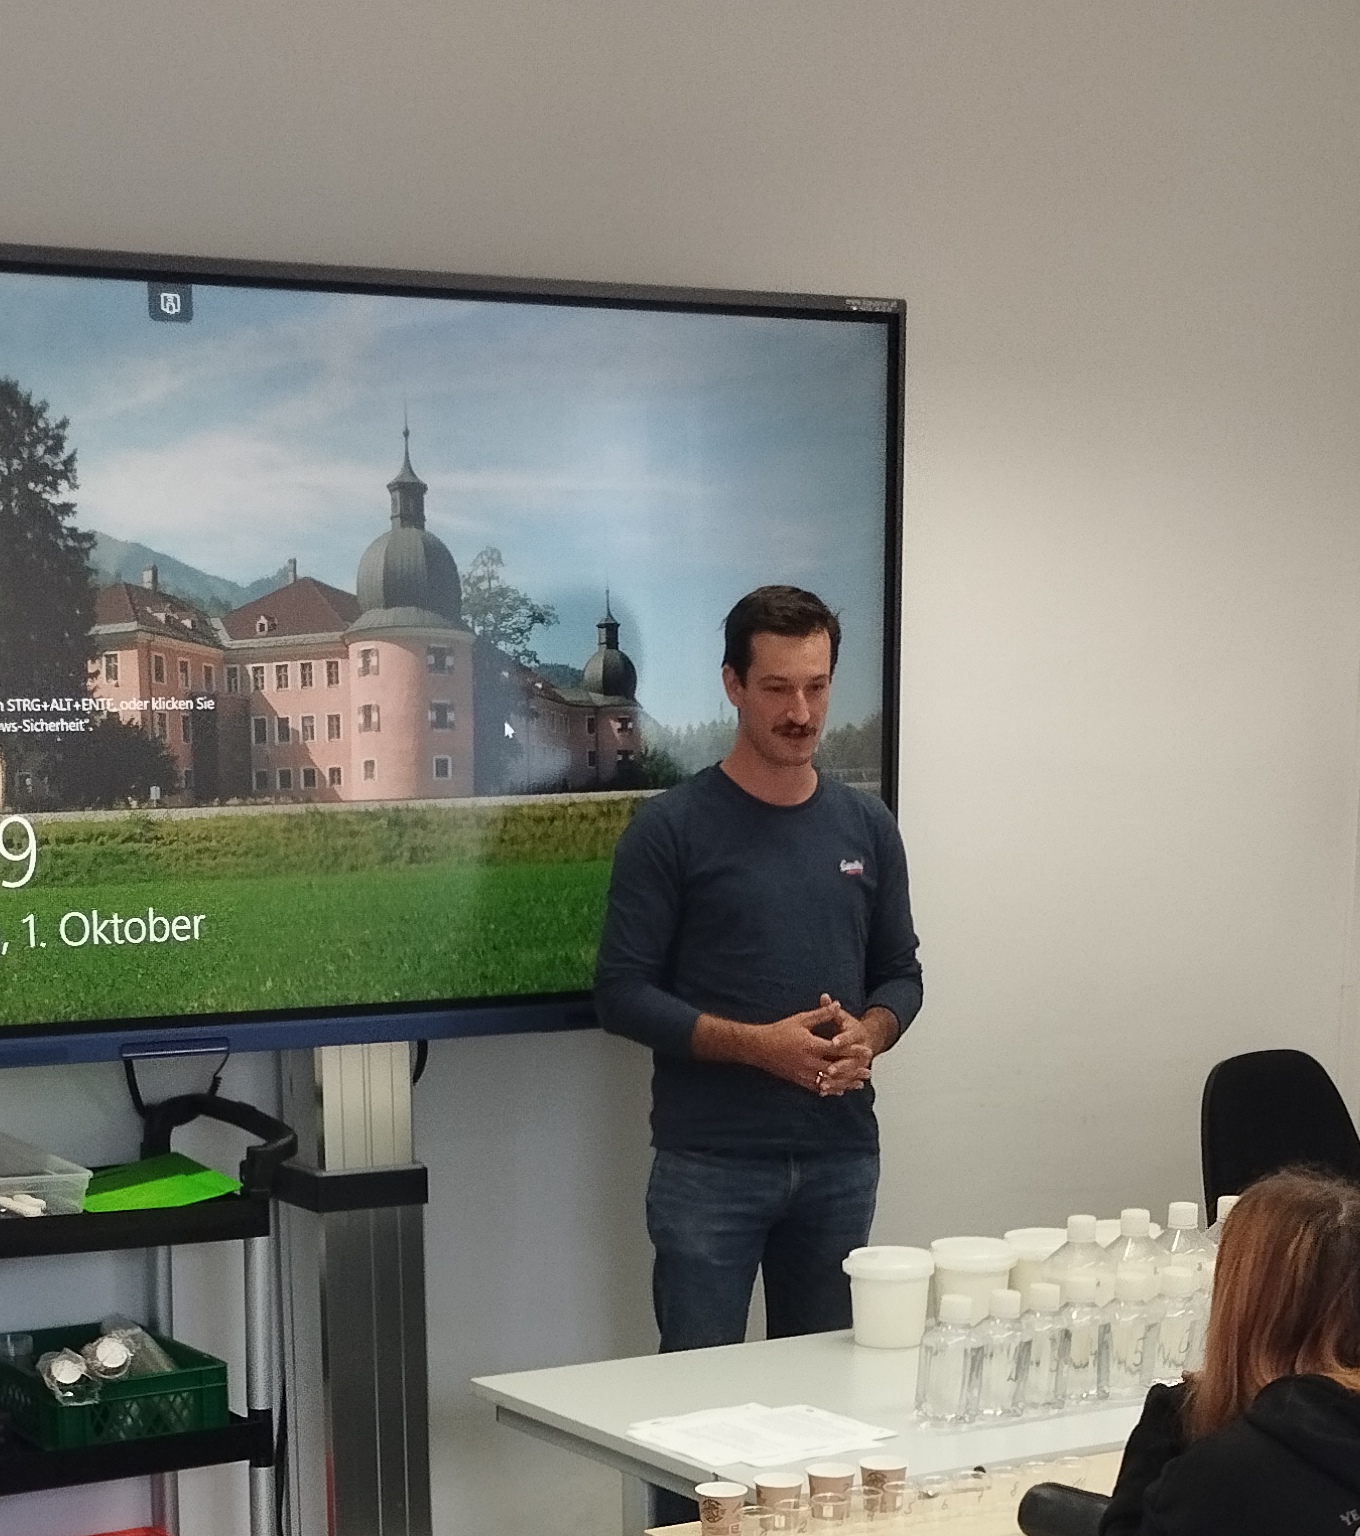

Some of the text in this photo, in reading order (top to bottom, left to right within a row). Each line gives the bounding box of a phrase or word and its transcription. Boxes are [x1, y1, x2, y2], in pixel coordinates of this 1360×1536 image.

[120, 698, 149, 711] oder
[152, 697, 194, 710] klicken
[196, 697, 215, 710] Sie
[21, 913, 47, 949] 1.
[59, 907, 207, 947] Oktober
